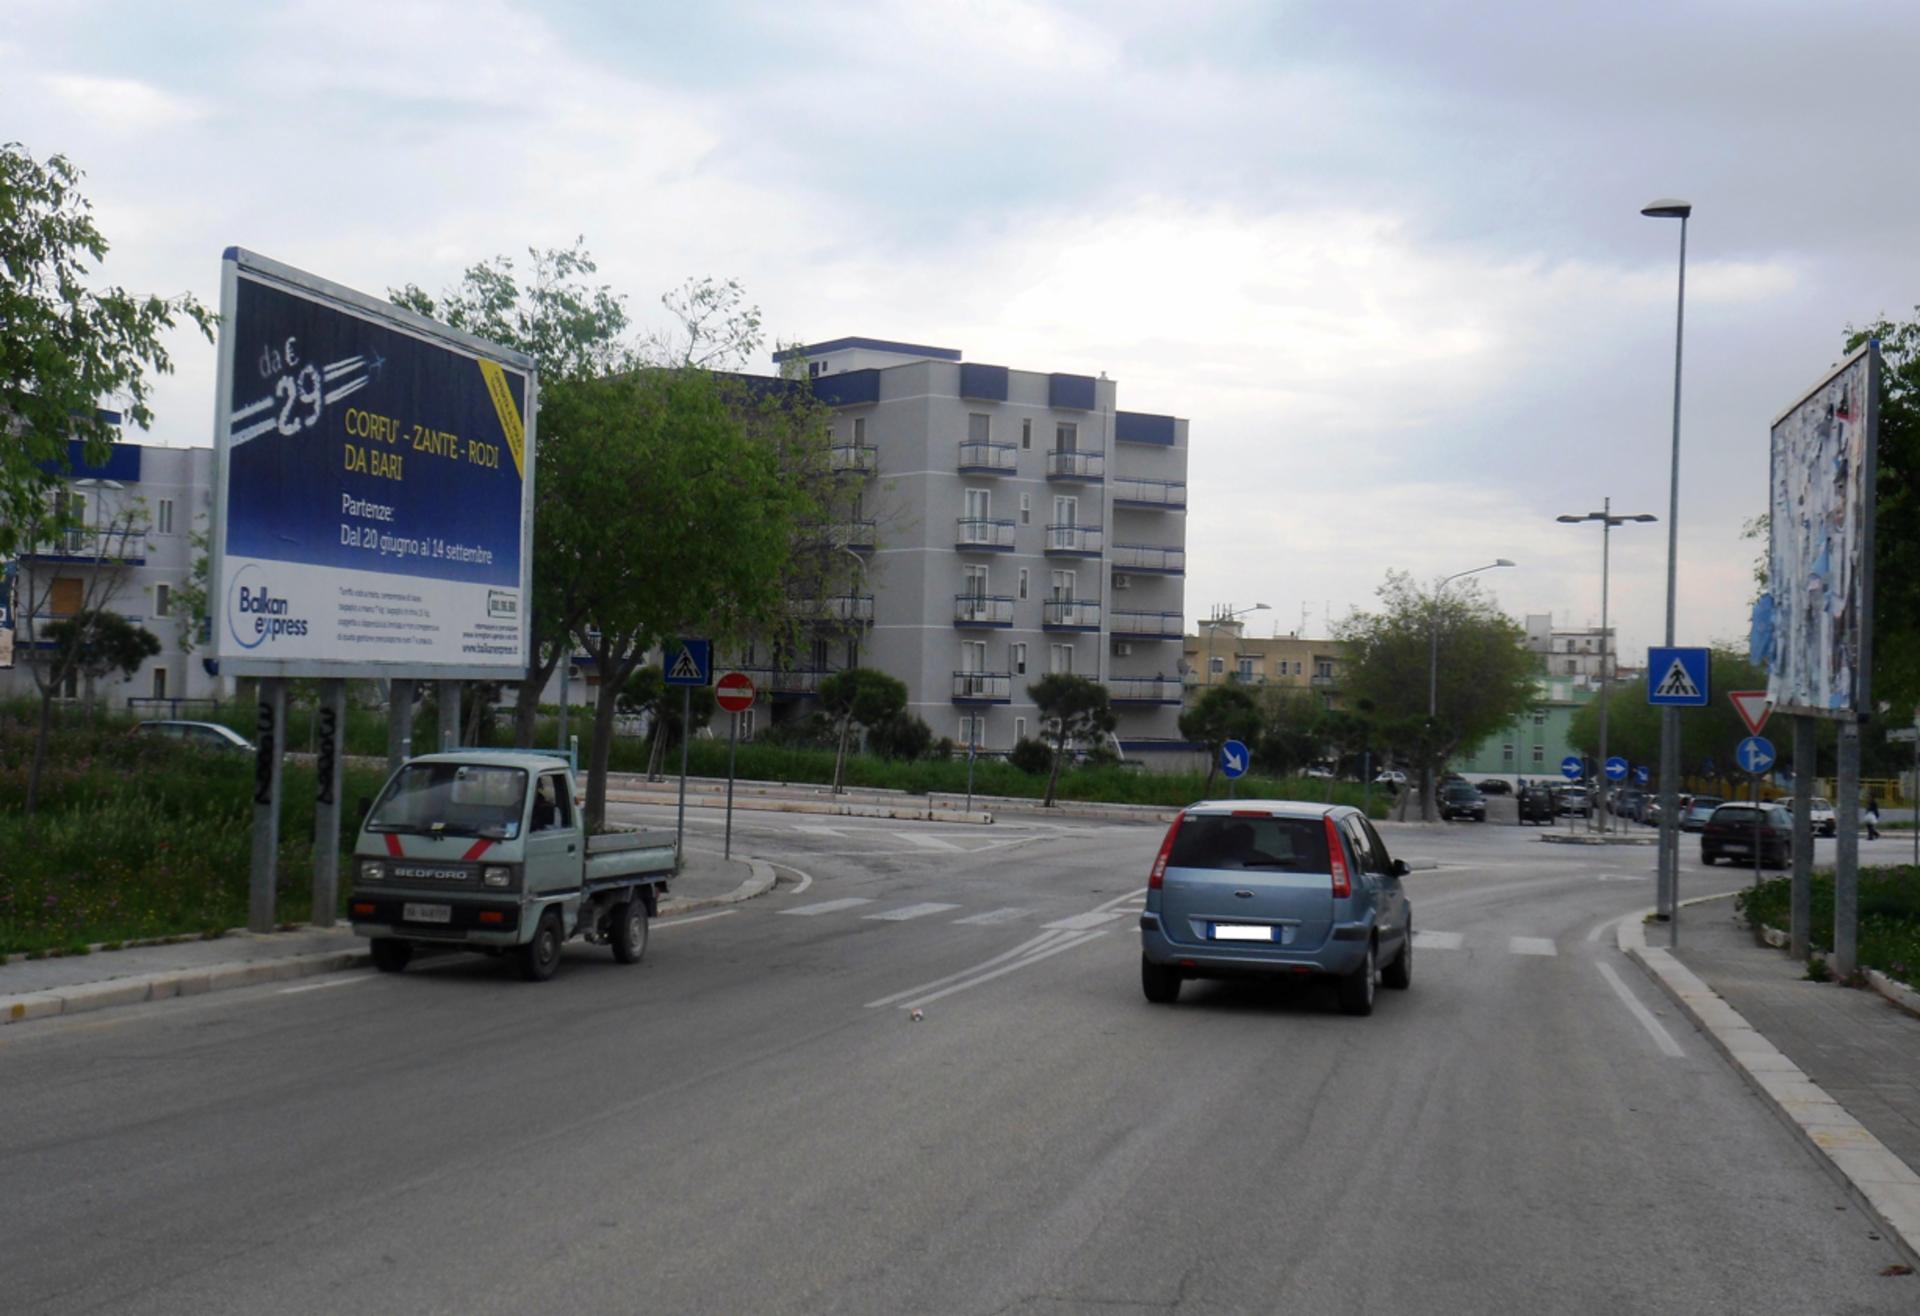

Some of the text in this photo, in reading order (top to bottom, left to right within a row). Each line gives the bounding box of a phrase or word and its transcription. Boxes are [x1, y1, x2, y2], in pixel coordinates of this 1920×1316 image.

[276, 364, 322, 436] 29
[345, 407, 400, 444] CORFU'
[412, 424, 458, 460] ZANTE
[468, 439, 499, 469] RODI
[344, 444, 403, 481] DA BARI
[342, 493, 395, 522] Partenze:
[340, 524, 493, 564] Dal 20 giugno al 14 settembre
[240, 586, 288, 615] Balkan
[255, 616, 308, 642] express
[395, 867, 467, 879] BEDFORD
